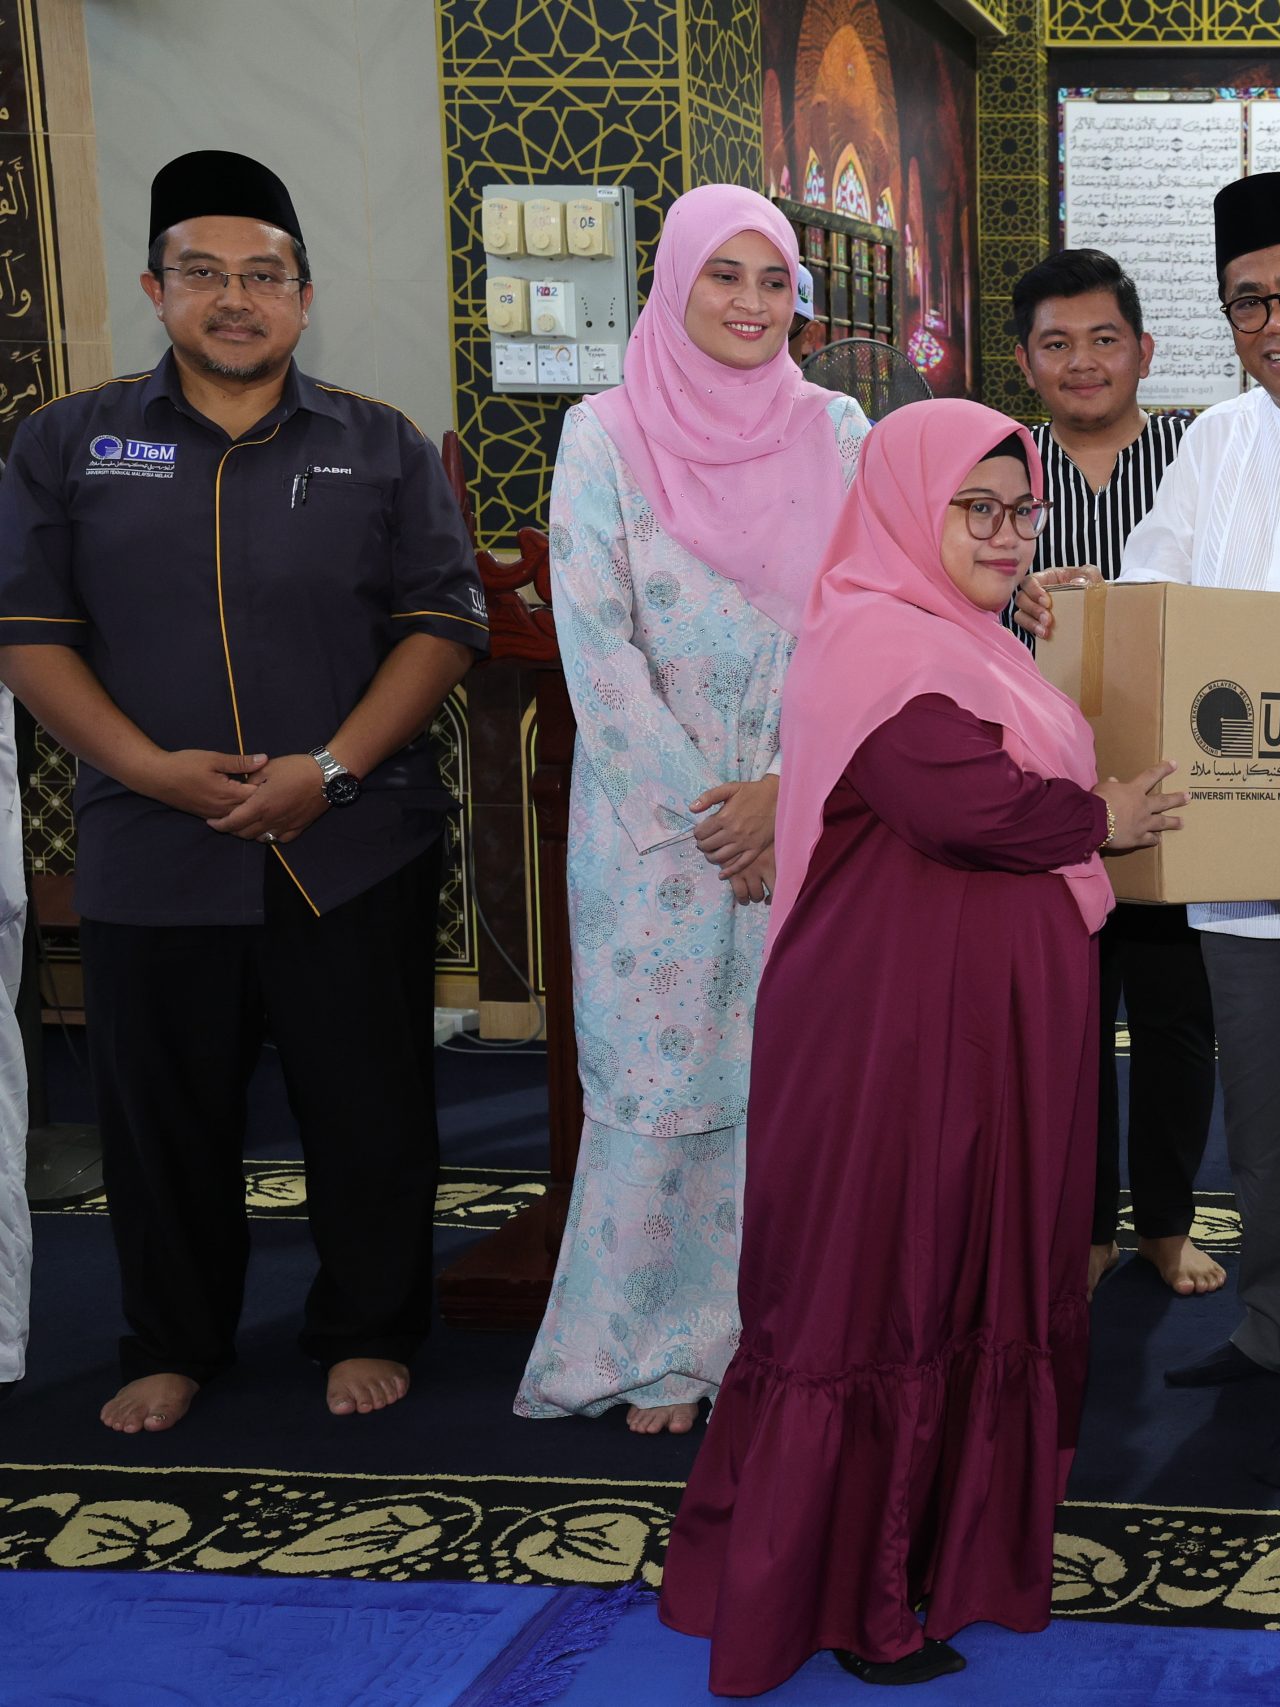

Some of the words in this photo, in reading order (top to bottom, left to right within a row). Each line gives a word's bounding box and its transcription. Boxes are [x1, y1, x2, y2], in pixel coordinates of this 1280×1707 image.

[580, 217, 596, 229] 05
[500, 294, 514, 304] 03
[127, 442, 175, 460] UTeM
[313, 466, 352, 475] SABRI
[1208, 682, 1237, 691] MALAYSIA
[1239, 690, 1253, 718] MELAKA
[1236, 791, 1276, 801] TEKNIKAL
